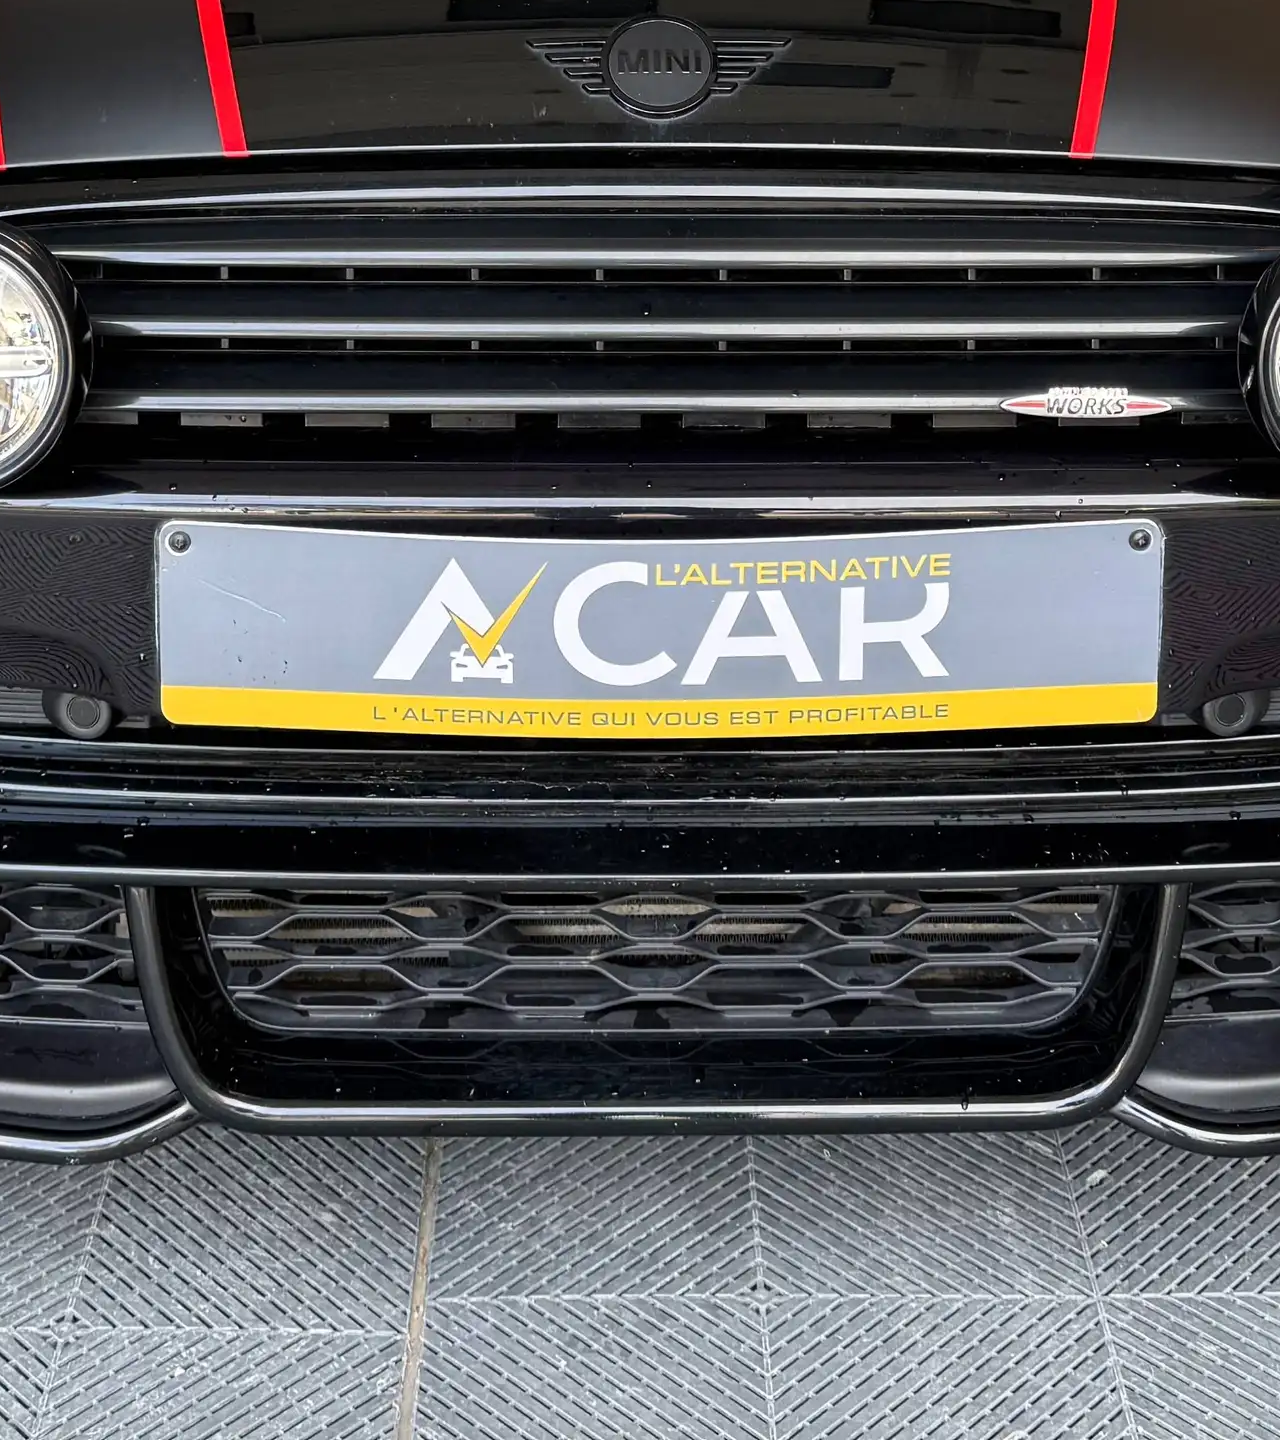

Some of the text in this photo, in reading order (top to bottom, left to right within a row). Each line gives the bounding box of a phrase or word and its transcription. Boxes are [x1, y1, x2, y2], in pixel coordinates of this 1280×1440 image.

[617, 48, 703, 75] MINI
[1047, 397, 1127, 415] WORKS
[655, 553, 952, 587] L'ALTERNATIVE
[591, 710, 636, 727] QUI
[644, 710, 720, 727] VOUS
[729, 708, 780, 726] EST
[788, 702, 950, 724] PROFITABLE
